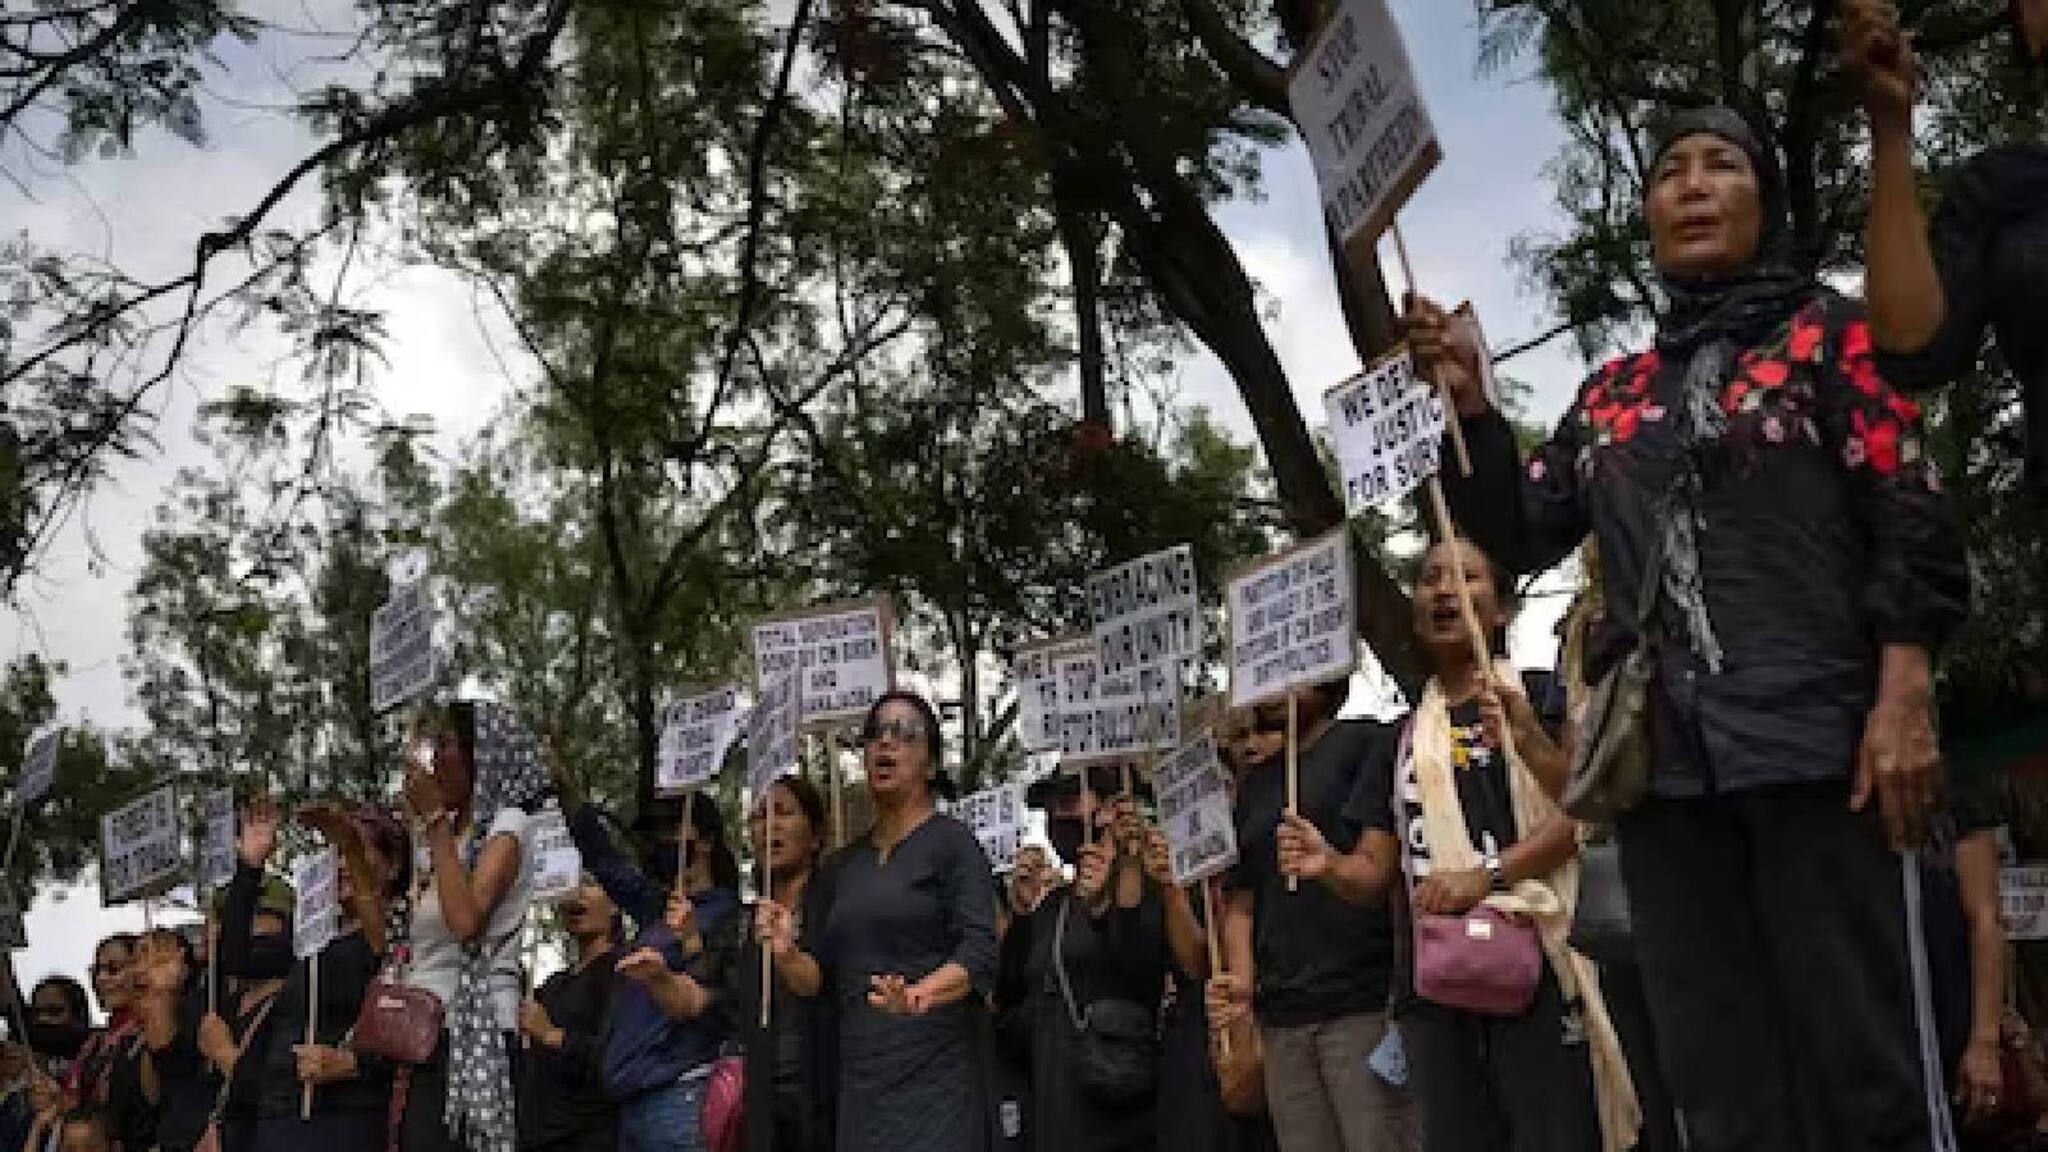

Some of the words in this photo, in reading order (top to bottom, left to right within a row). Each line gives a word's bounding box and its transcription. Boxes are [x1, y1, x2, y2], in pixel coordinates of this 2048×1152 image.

[1317, 14, 1358, 94] STOP
[1328, 63, 1390, 158] TRIBAL
[1341, 385, 1375, 426] WE
[1348, 464, 1389, 506] FOR
